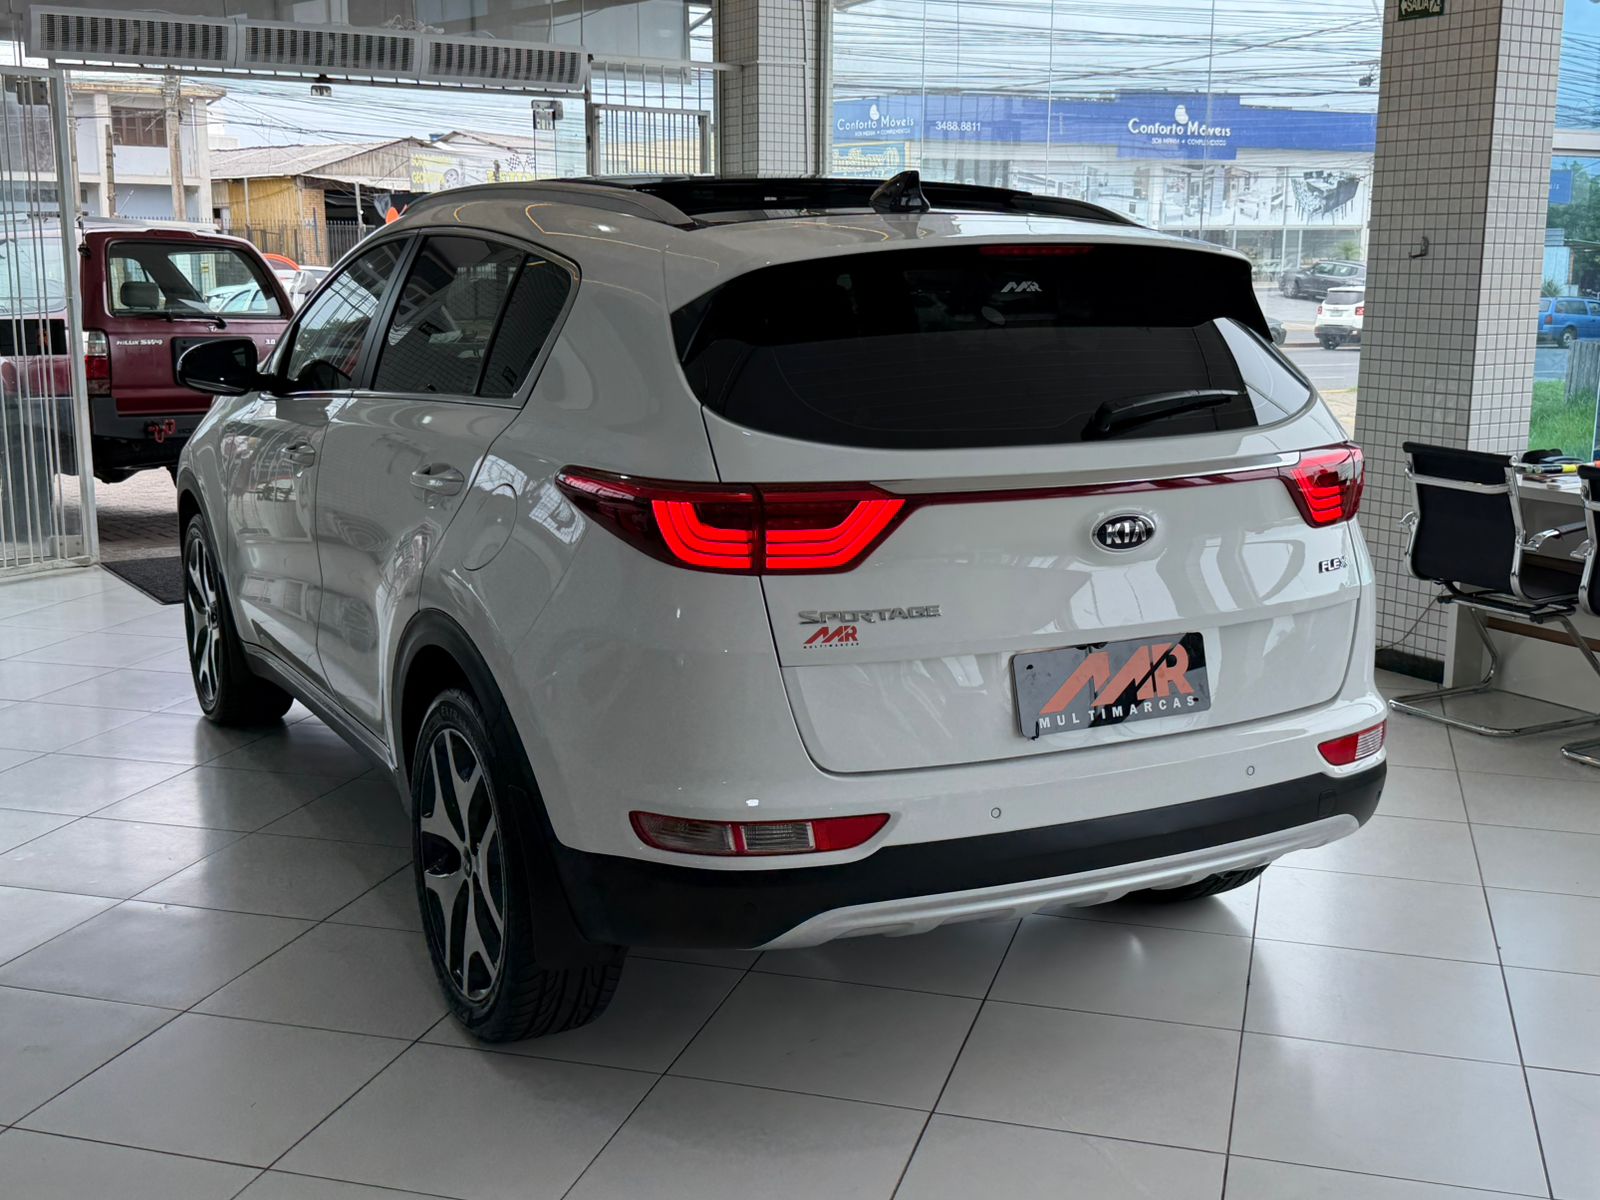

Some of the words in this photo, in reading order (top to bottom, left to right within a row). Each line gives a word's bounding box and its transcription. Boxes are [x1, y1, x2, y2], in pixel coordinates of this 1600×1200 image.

[836, 118, 877, 131] Conforto
[935, 120, 981, 131] 3488.8811
[1127, 117, 1185, 134] Conforto
[1187, 120, 1232, 137] Móveis
[1105, 520, 1147, 545] KIA
[1318, 555, 1348, 574] FLEX
[797, 604, 943, 625] SPORTAGE
[1038, 694, 1197, 730] MULTIMARCAS
